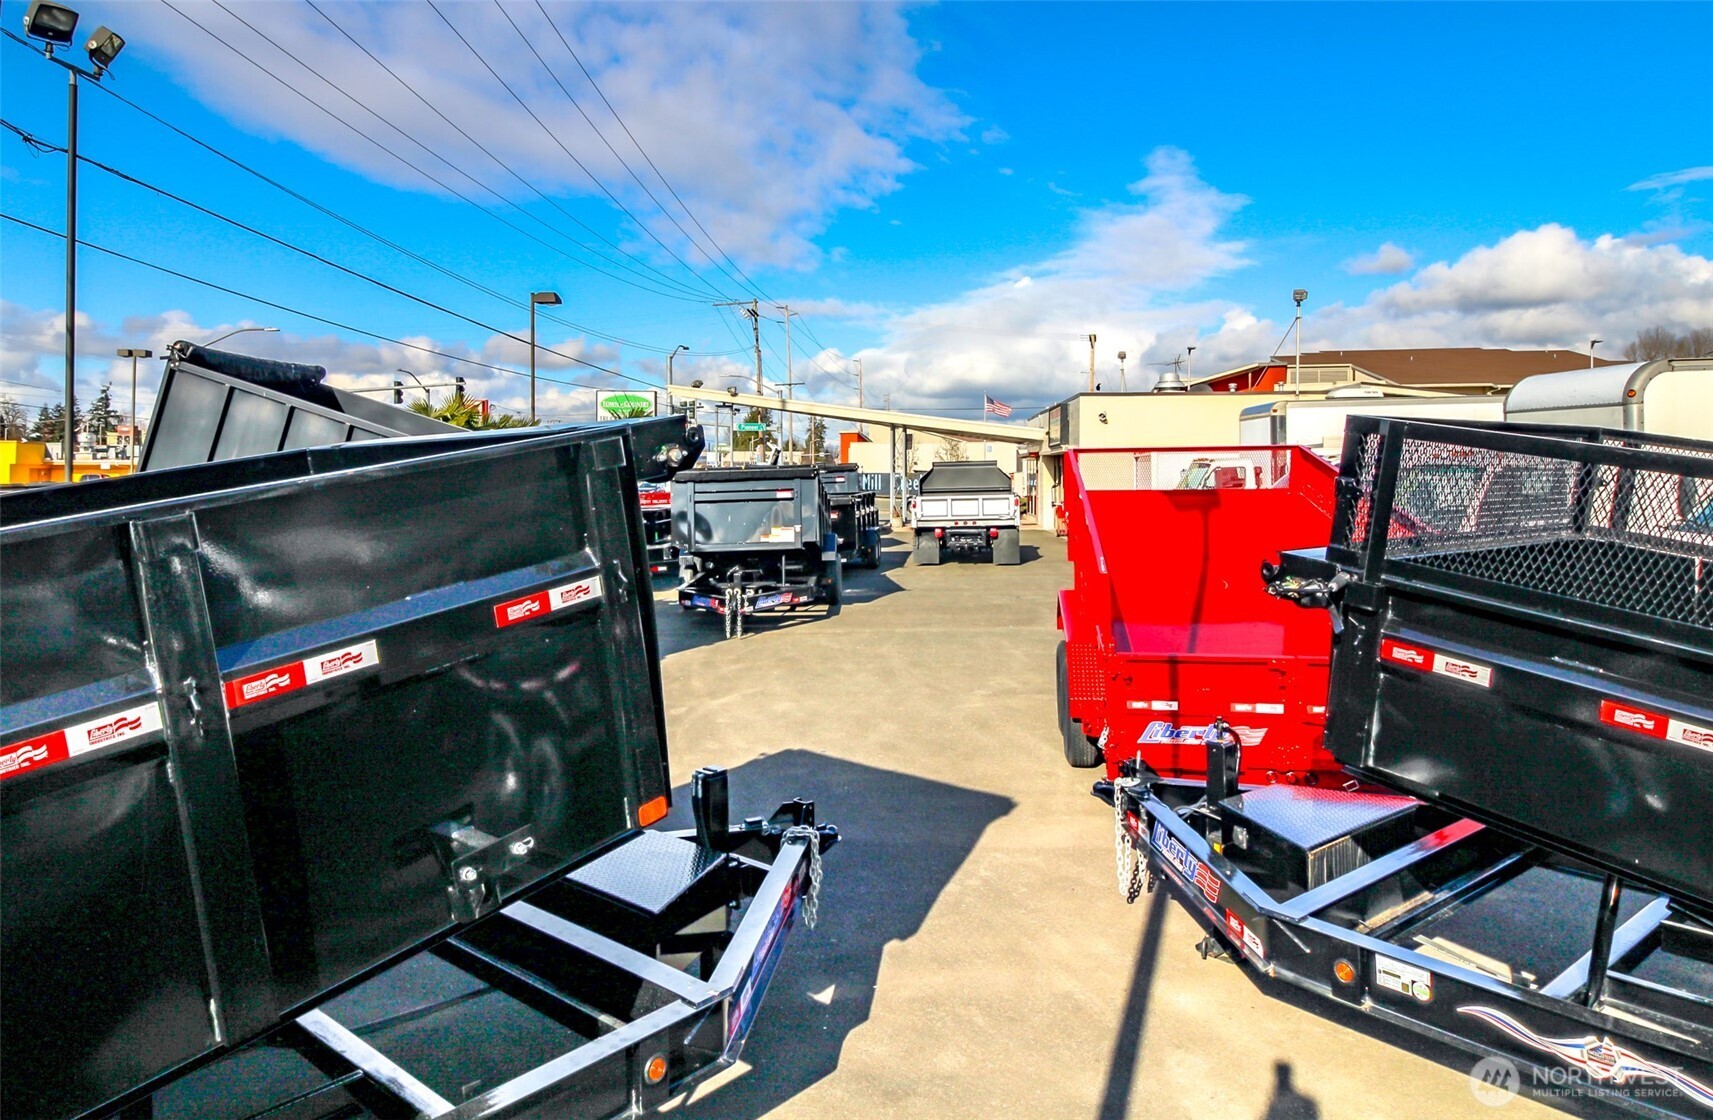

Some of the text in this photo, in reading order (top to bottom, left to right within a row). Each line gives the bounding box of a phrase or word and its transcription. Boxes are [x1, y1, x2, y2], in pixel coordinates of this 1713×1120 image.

[863, 474, 922, 490] Mill Cree
[246, 681, 266, 694] Liberty
[1151, 819, 1198, 882] Liberty
